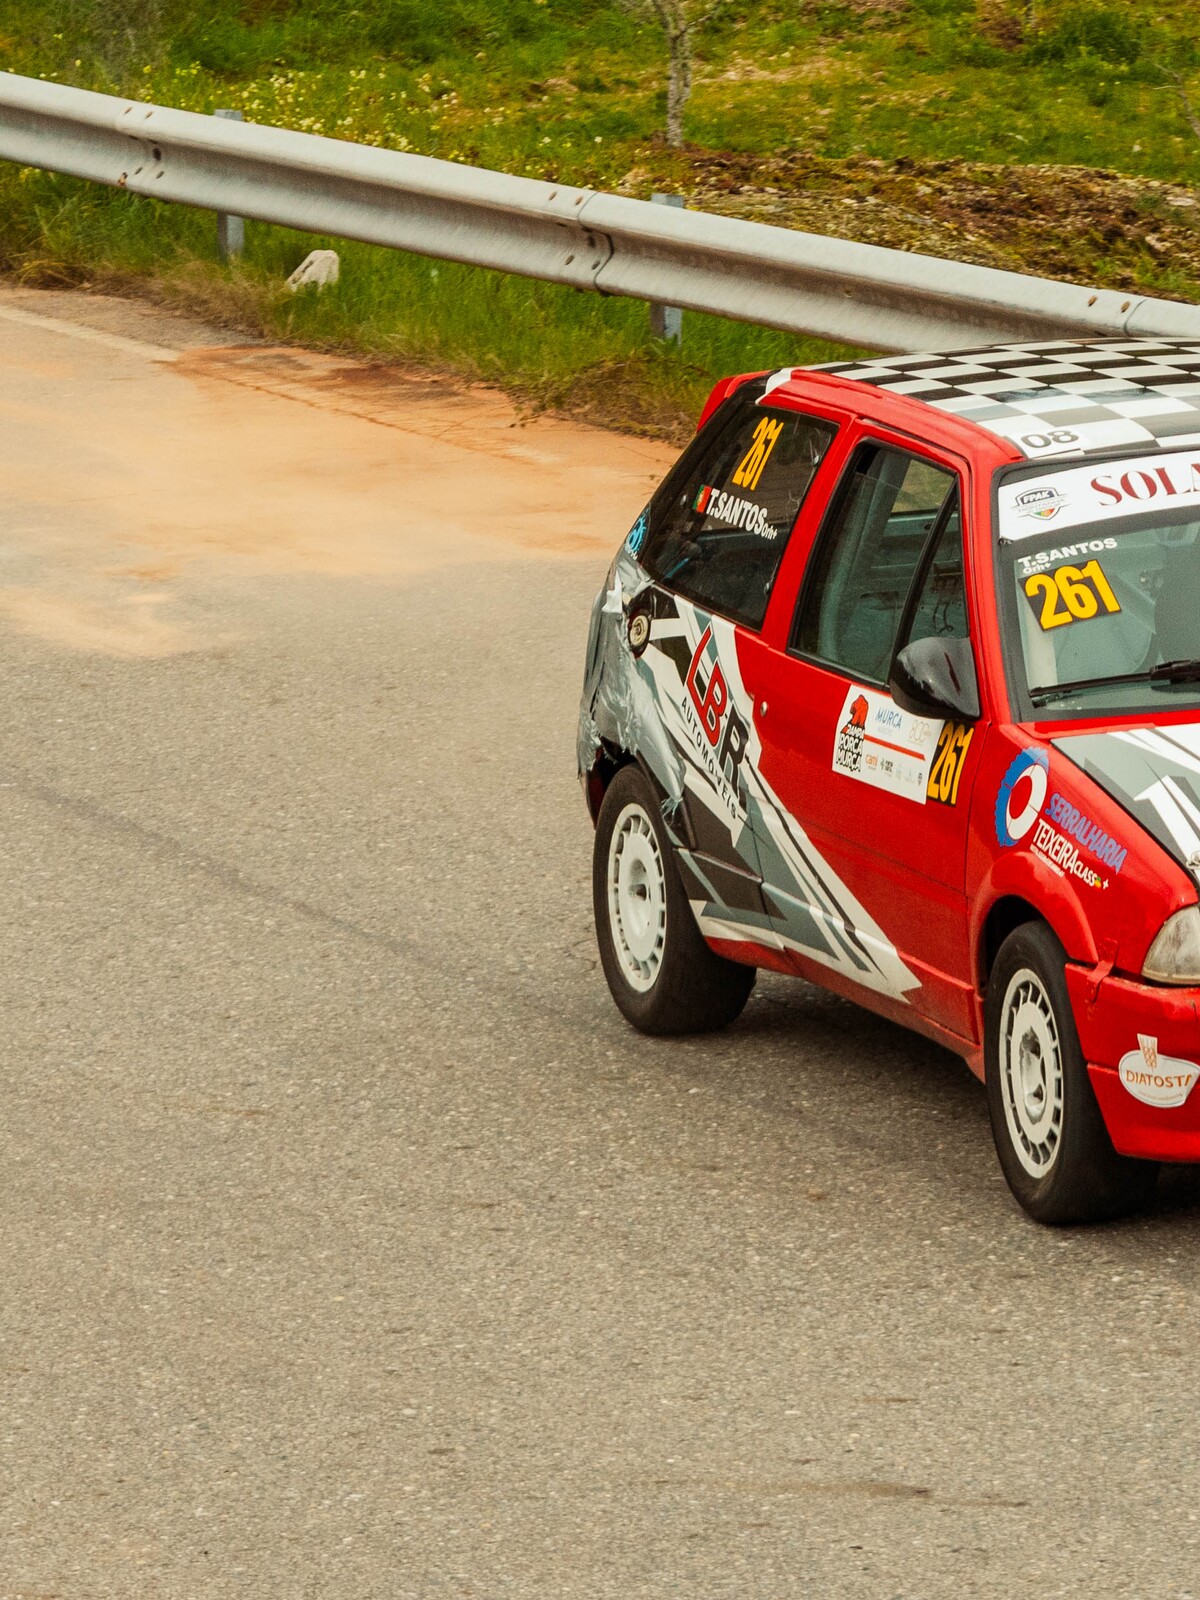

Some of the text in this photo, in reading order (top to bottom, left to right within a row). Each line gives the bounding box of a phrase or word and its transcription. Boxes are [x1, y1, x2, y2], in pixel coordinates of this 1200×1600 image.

[732, 416, 784, 491] 261
[1021, 431, 1080, 449] 08
[705, 488, 768, 534] T.SANTOS
[1022, 490, 1051, 504] FPAK
[1017, 538, 1118, 568] T.SANTOS
[1025, 559, 1120, 630] 261
[927, 721, 975, 805] 261
[1045, 793, 1128, 875] SERRALHARIA
